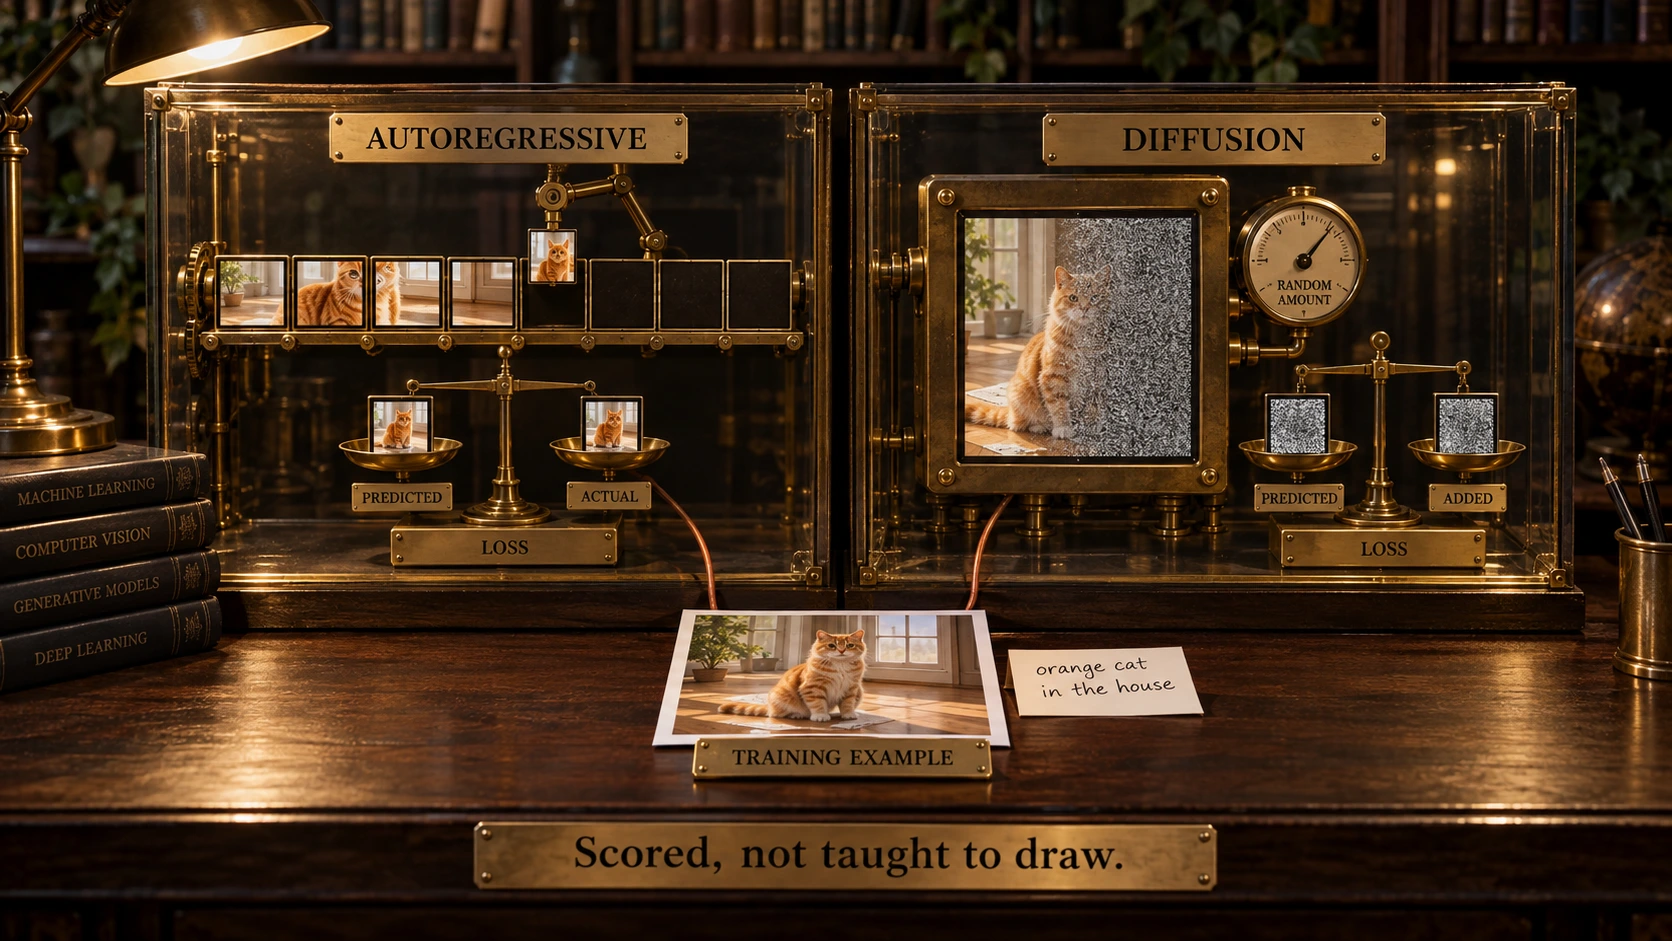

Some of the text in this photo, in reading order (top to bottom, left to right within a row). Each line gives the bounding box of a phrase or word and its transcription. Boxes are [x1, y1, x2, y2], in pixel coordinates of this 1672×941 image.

[366, 126, 647, 150] AUTOREGRESSIVE
[1122, 127, 1305, 152] DIFFUSION
[1277, 279, 1332, 291] RANDOM
[1277, 294, 1332, 306] AMOUNT
[17, 477, 156, 507] MACHINE LEARNING
[362, 491, 443, 505] PREDICTED
[581, 490, 639, 503] ACTUAL
[1261, 492, 1338, 505] PREDICTED
[1443, 492, 1493, 505] ADDED
[15, 526, 151, 560] COMPUTER VISION
[481, 539, 529, 556] LOSS
[1361, 541, 1408, 557] LOSS
[13, 576, 160, 614] GENERATIVE MODELS
[34, 631, 148, 666] DEEP LEARNING
[1036, 657, 1148, 680] orange cat
[1041, 678, 1176, 698] in the house
[732, 749, 954, 766] TRAINING EXAMPLE
[574, 834, 1124, 878] Scored, not taught to draw.
